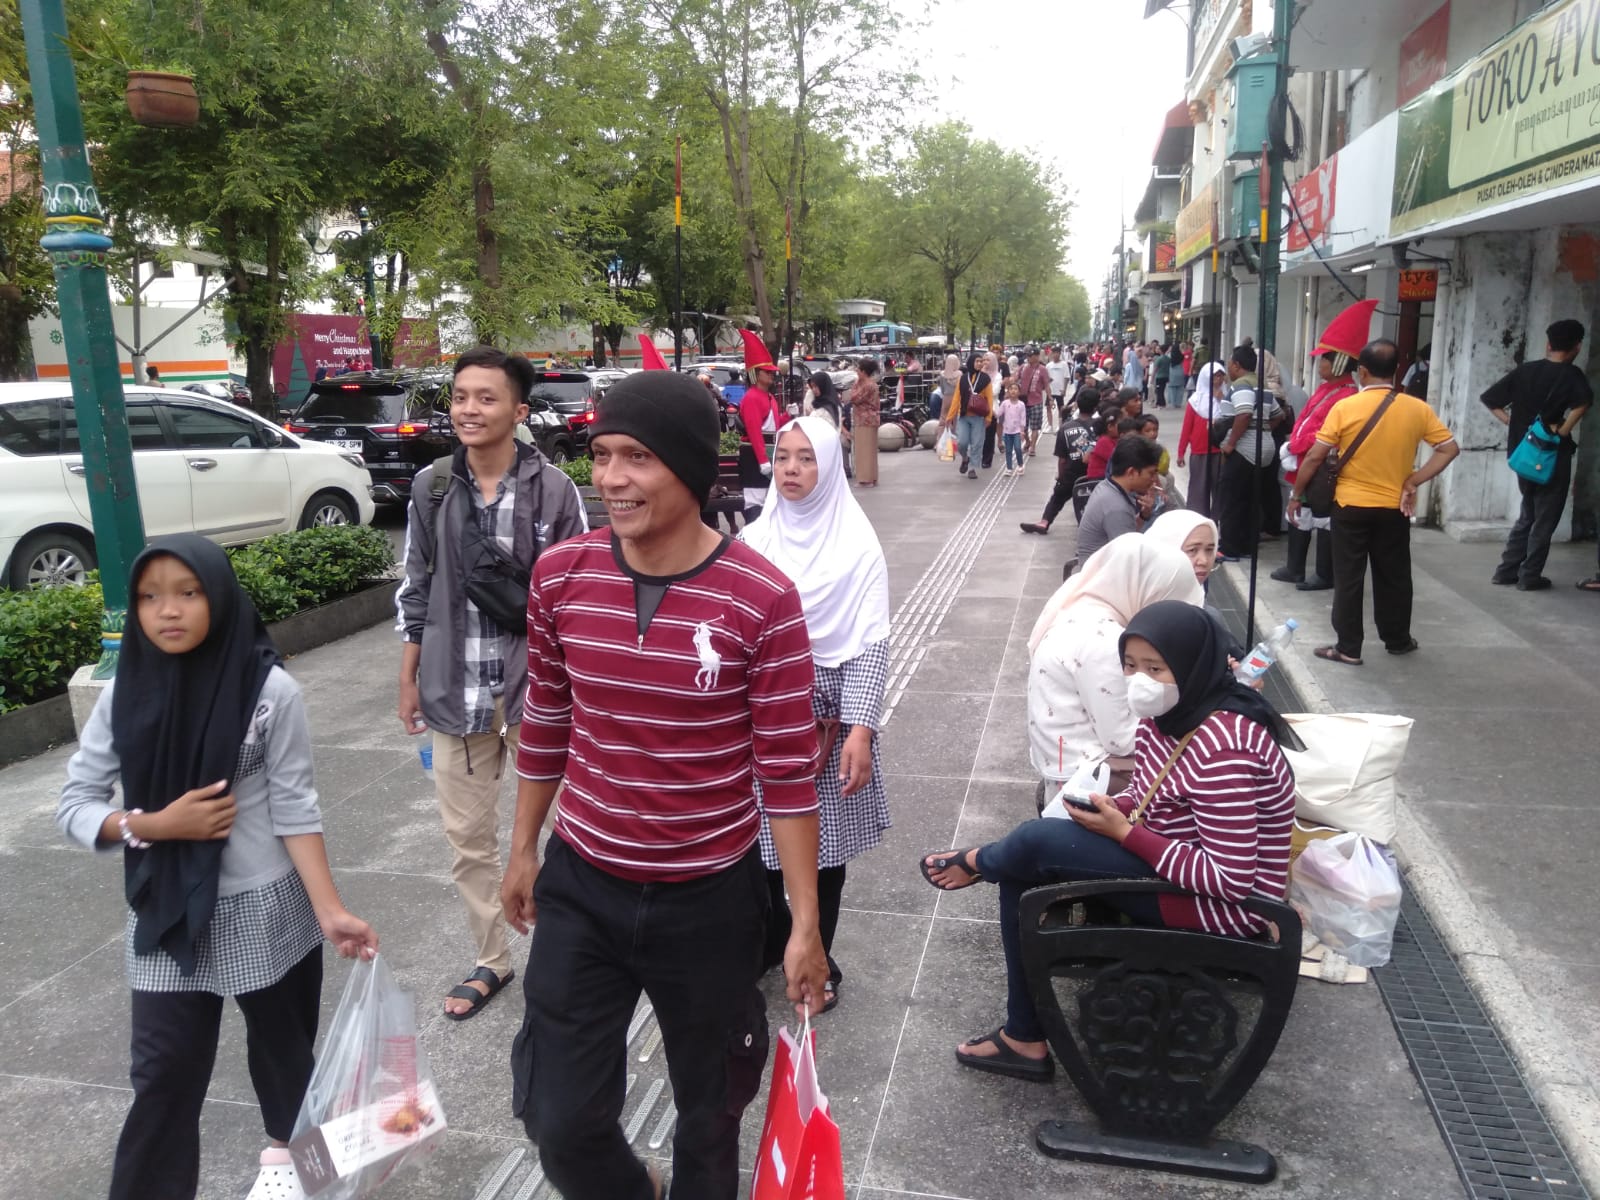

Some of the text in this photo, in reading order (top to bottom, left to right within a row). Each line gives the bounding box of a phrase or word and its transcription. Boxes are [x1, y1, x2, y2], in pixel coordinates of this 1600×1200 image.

[1464, 32, 1538, 131] TOKO
[1477, 151, 1600, 203] PUSAT OLEH-OLEH & CINDERAMAT
[314, 328, 356, 344] Merry Christmas
[333, 346, 343, 355] and
